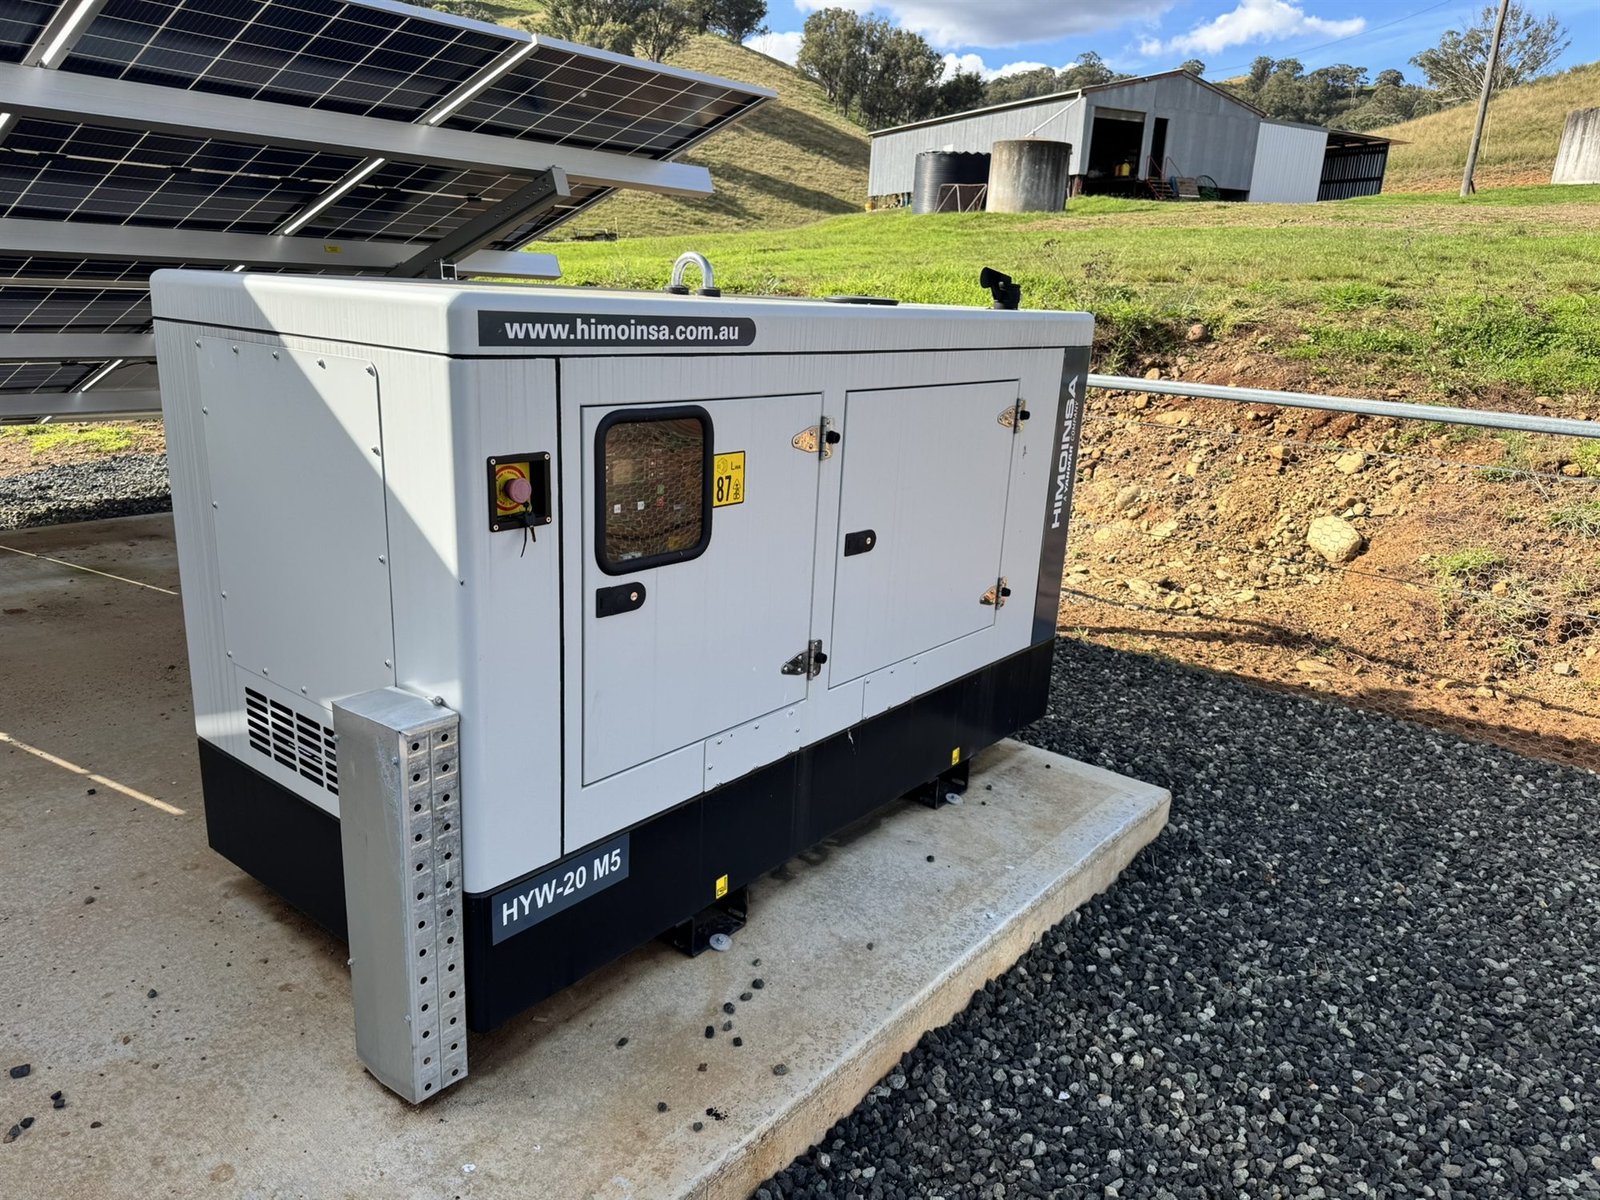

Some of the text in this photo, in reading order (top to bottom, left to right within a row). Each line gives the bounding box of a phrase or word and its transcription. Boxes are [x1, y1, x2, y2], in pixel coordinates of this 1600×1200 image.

[504, 318, 739, 340] www.himoinsa.com.au
[1051, 375, 1079, 529] HIMOINSA
[1064, 445, 1074, 493] YANMAR
[1071, 400, 1079, 442] COMPANY
[716, 475, 732, 503] 87
[502, 848, 621, 926] HYW-20 M5
